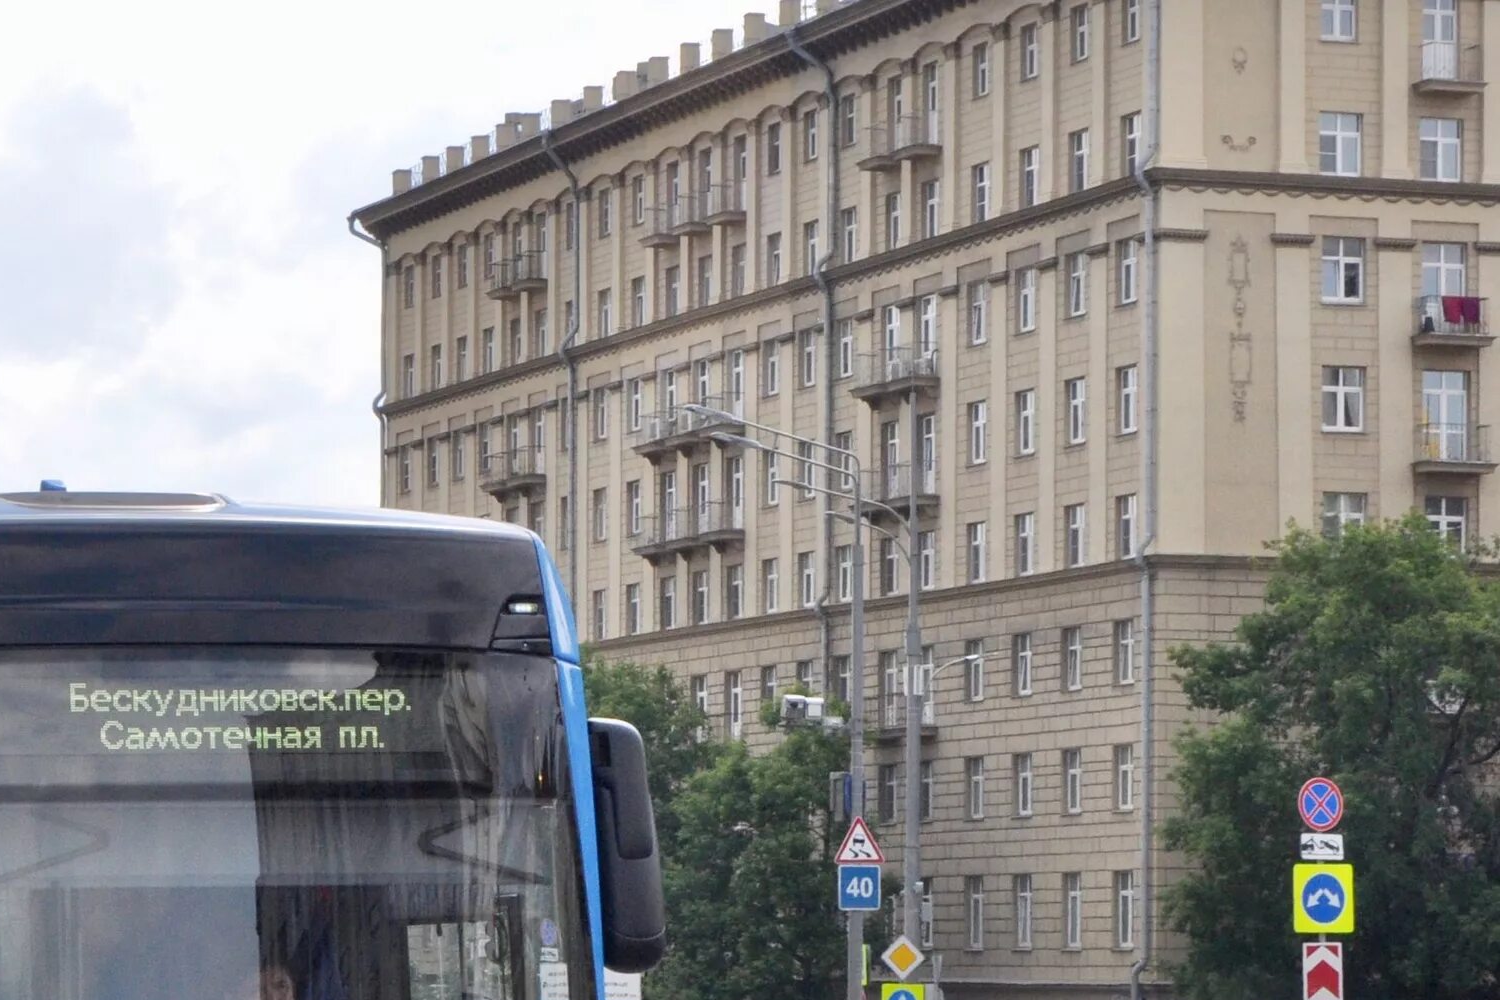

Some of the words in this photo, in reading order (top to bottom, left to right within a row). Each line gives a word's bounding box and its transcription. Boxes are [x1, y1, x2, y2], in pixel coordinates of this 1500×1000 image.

[100, 721, 322, 751] Самотечная
[340, 723, 386, 750] пл.
[846, 876, 874, 898] 40
